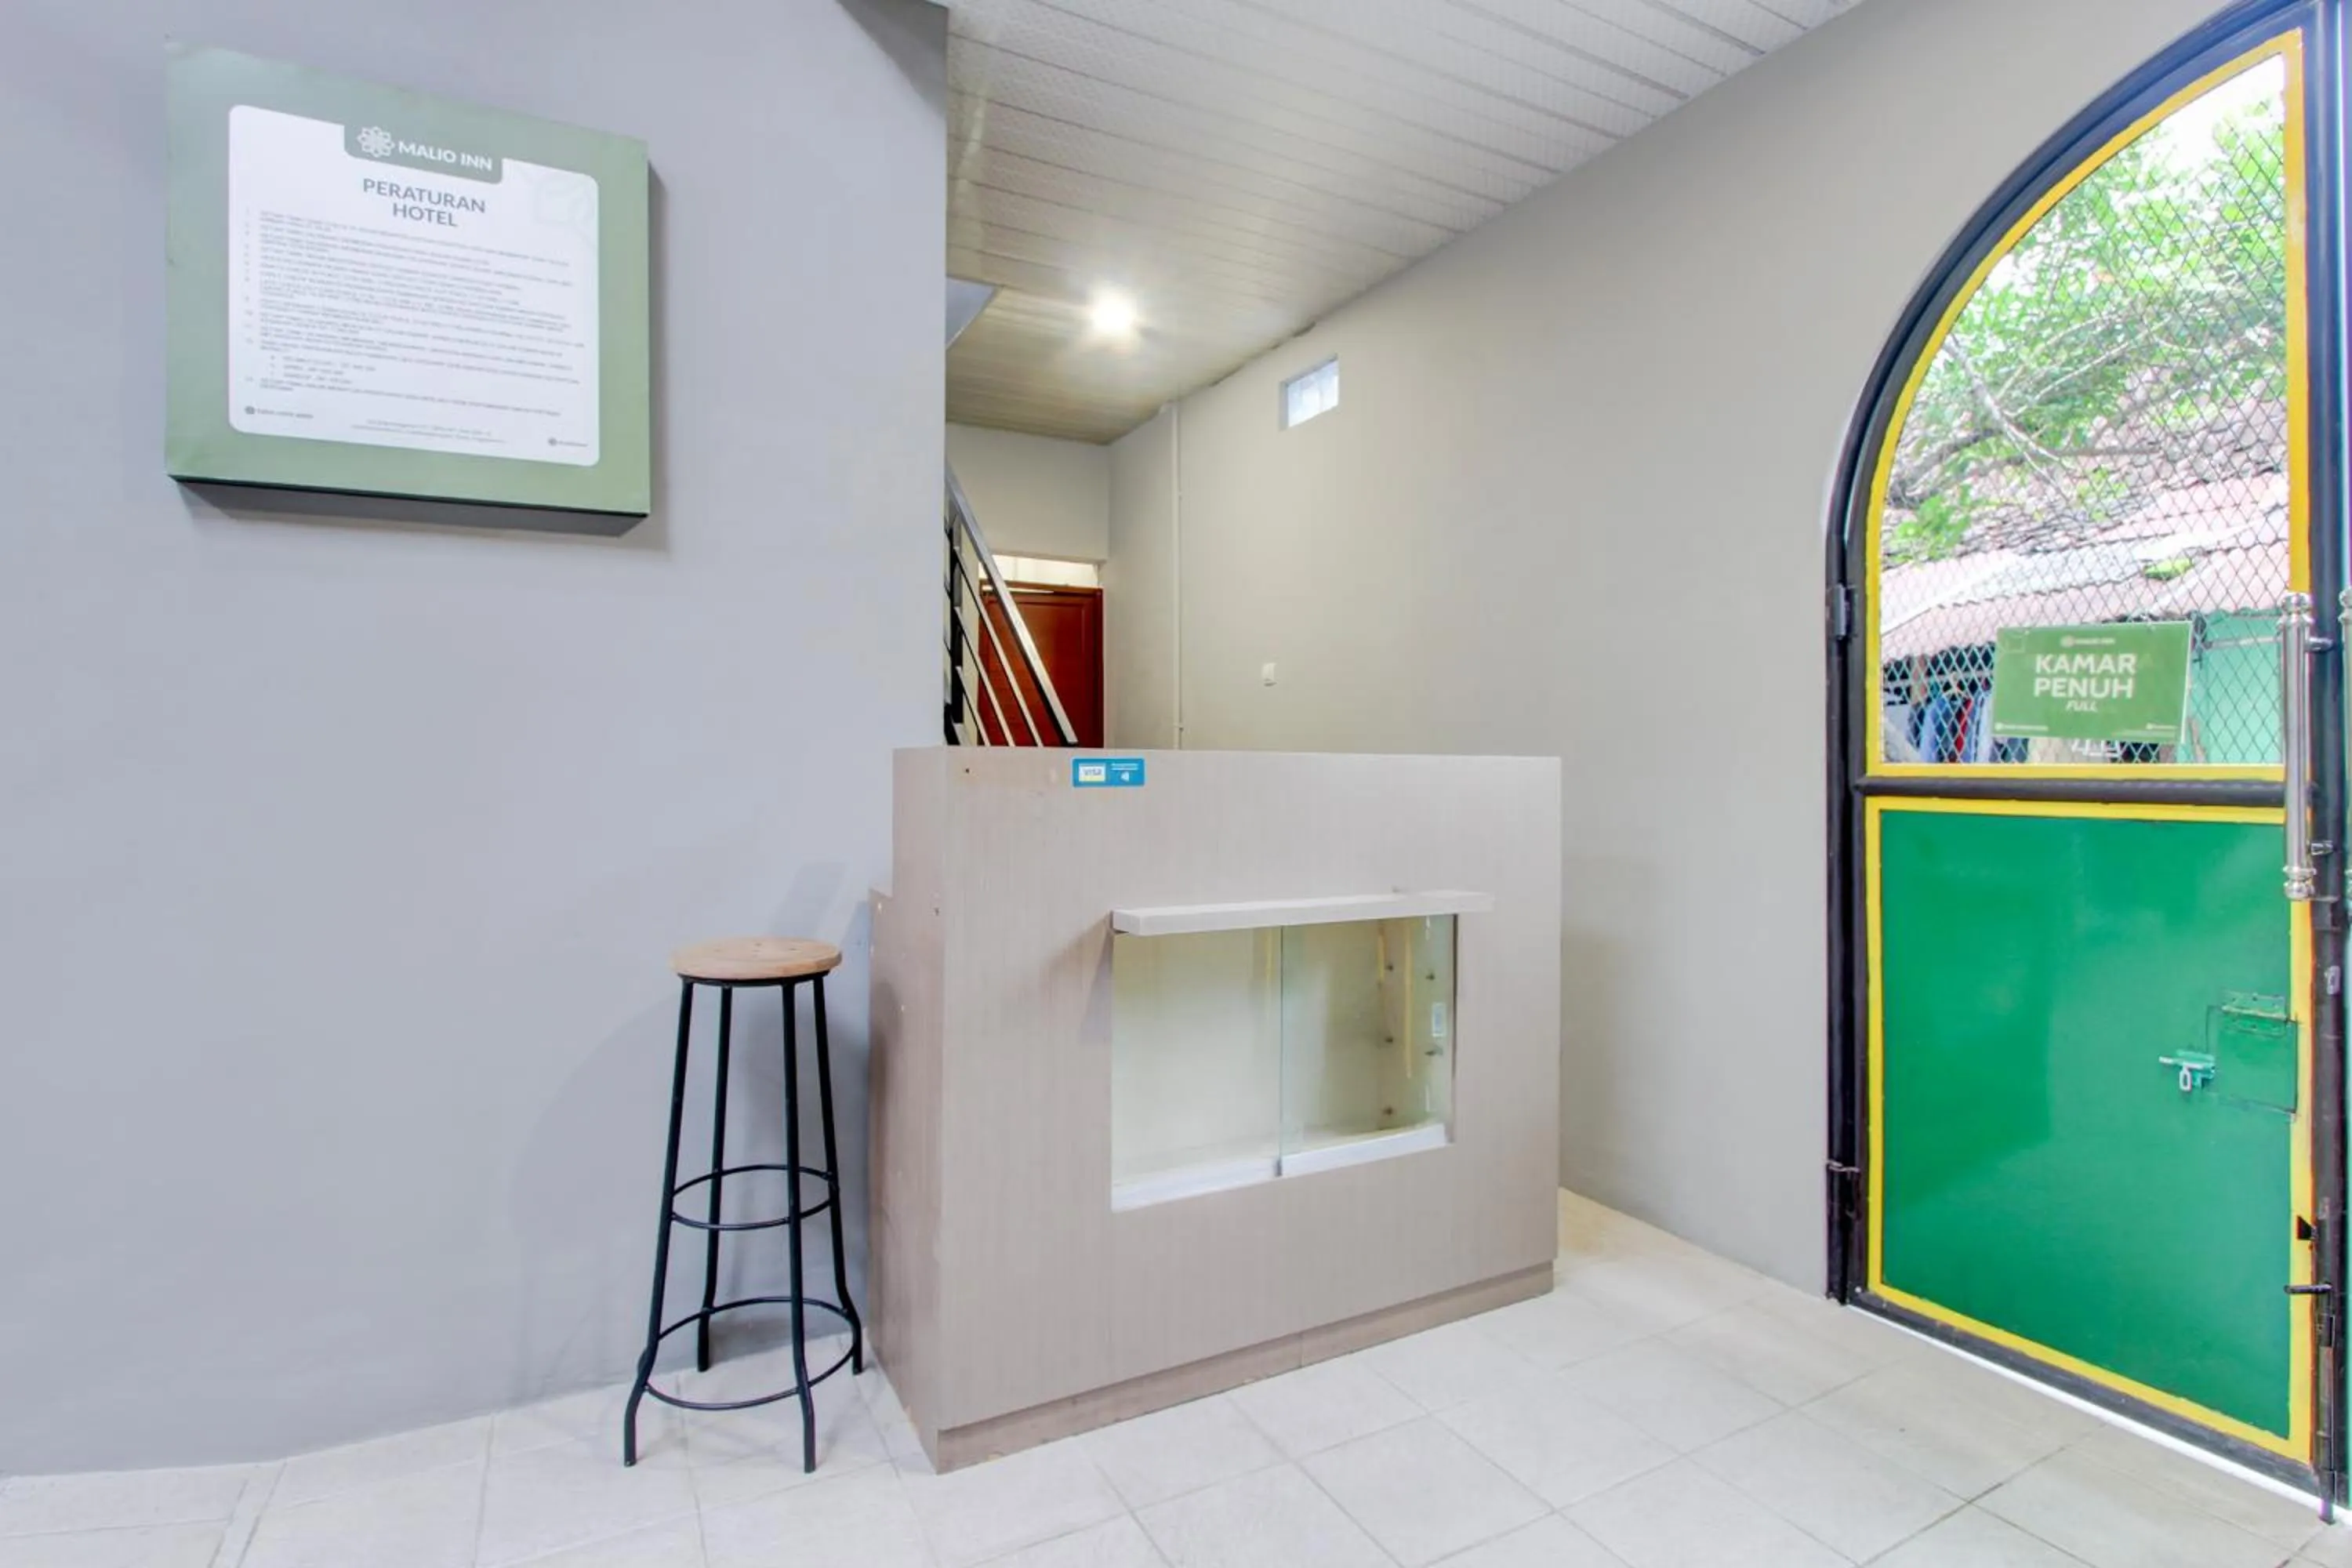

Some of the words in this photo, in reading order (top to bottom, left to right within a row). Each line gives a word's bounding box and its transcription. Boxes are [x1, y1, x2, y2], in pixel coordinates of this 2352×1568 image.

[397, 140, 456, 165] MALIO
[460, 151, 493, 172] INN
[363, 178, 486, 214] PERATURAN
[393, 203, 458, 227] HOTEL
[2036, 653, 2136, 675] KAMAR
[2034, 677, 2134, 699] PENUH
[2066, 700, 2098, 713] FULL
